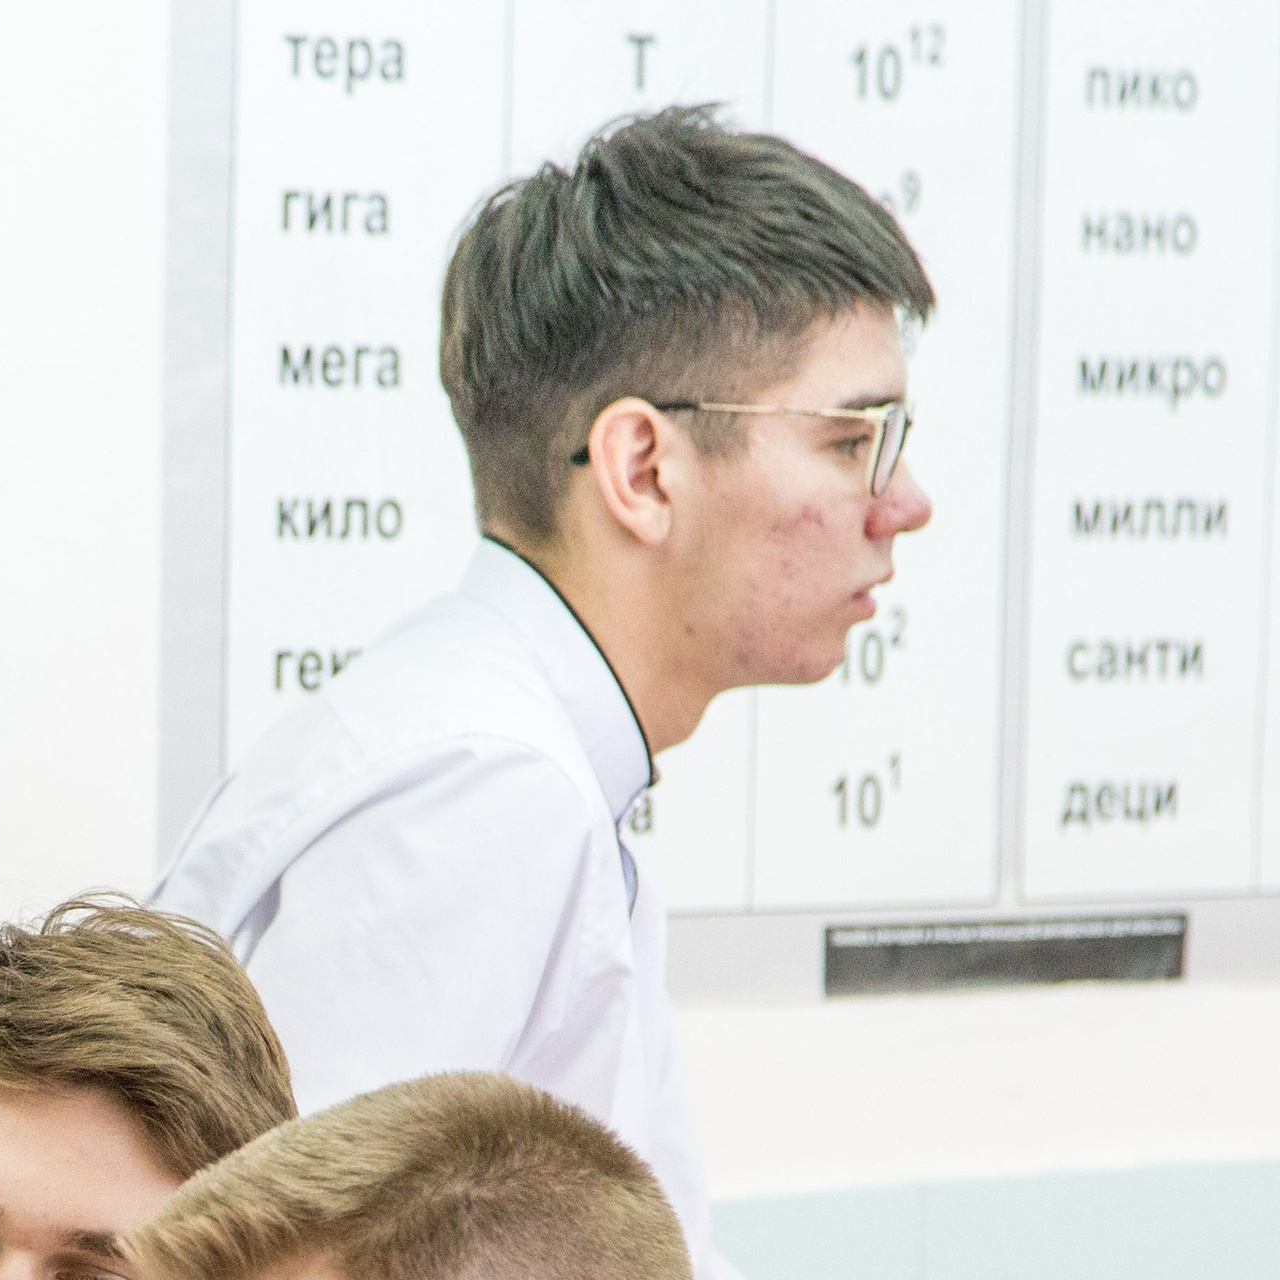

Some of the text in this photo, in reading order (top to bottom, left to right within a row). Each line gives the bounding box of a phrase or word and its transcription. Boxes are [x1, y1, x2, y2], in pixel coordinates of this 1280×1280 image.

[282, 33, 406, 97] тера
[1083, 64, 1200, 115] пико
[279, 187, 392, 238] гига
[1079, 211, 1200, 258] нано
[276, 342, 403, 391] мега
[1074, 353, 1229, 414] микро
[274, 495, 405, 543] кило
[1069, 495, 1230, 542] милли
[1063, 636, 1206, 684] санти
[1056, 777, 1180, 833] деци
